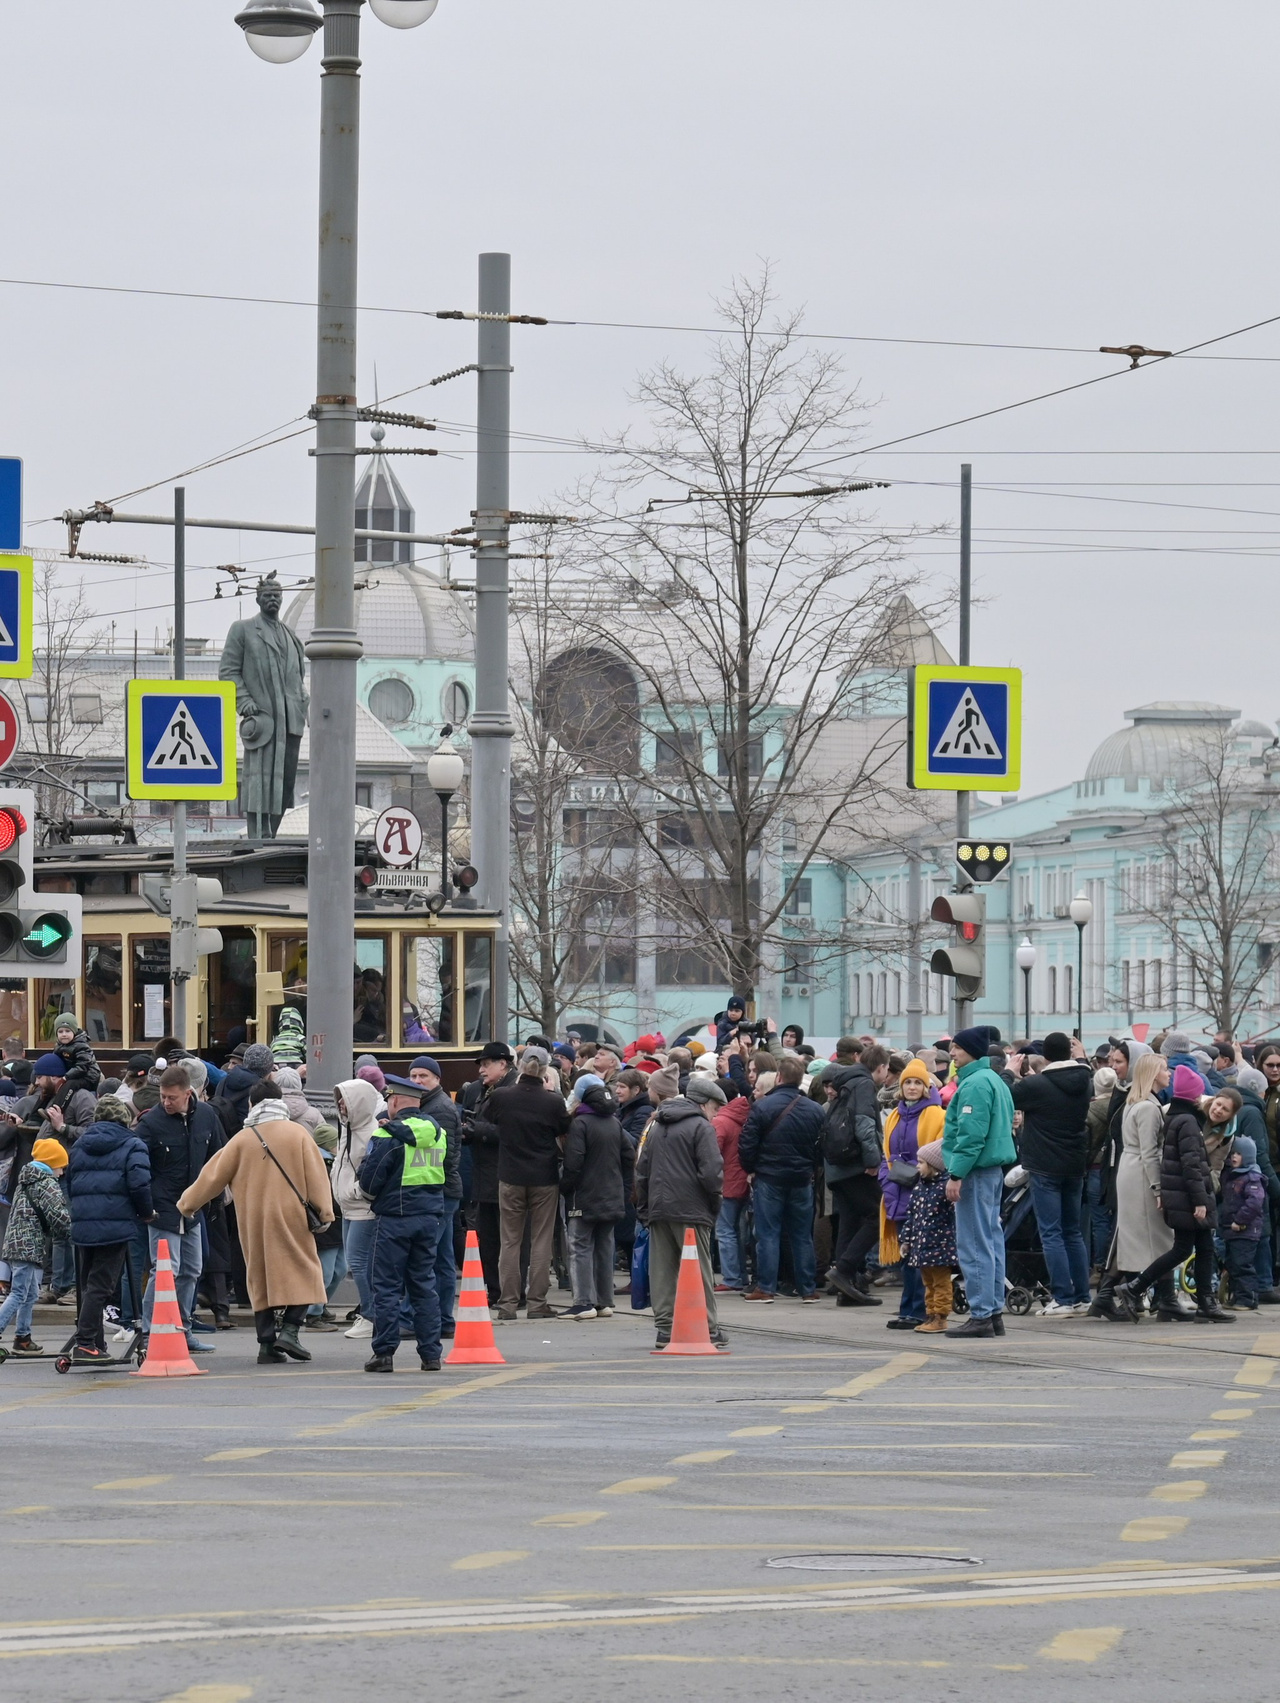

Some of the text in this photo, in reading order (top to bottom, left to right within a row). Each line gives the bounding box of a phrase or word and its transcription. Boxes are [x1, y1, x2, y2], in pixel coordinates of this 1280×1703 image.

[383, 817, 412, 855] А
[376, 874, 429, 887] ЛЬВАРНАЯ
[410, 1148, 444, 1167] ДПС
